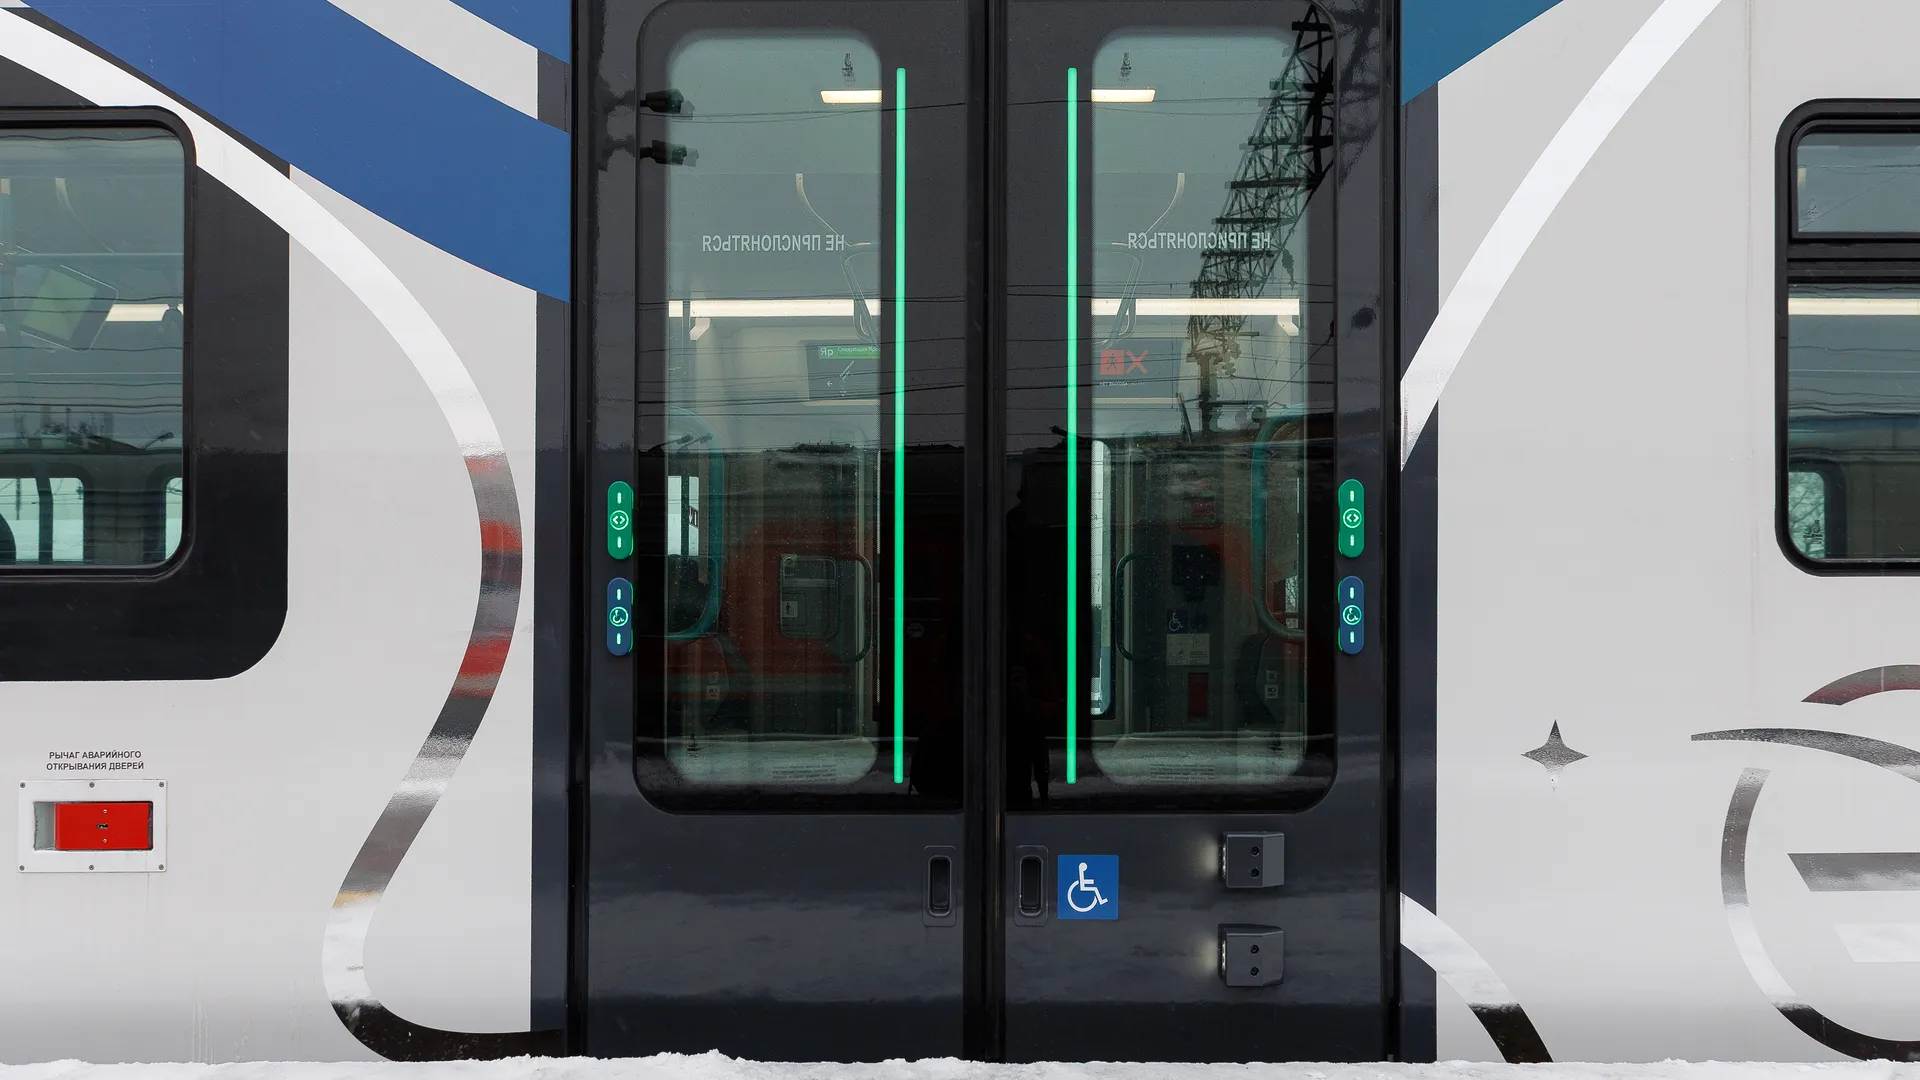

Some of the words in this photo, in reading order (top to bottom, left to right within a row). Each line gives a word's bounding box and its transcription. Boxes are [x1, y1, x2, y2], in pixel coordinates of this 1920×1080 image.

[49, 751, 80, 759] РЫЧАГ
[82, 749, 142, 759] АВАРИЙНОГО
[46, 762, 107, 771] ОТКРЫВАНИЯ
[108, 761, 144, 771] ДВЕРЕЙ
